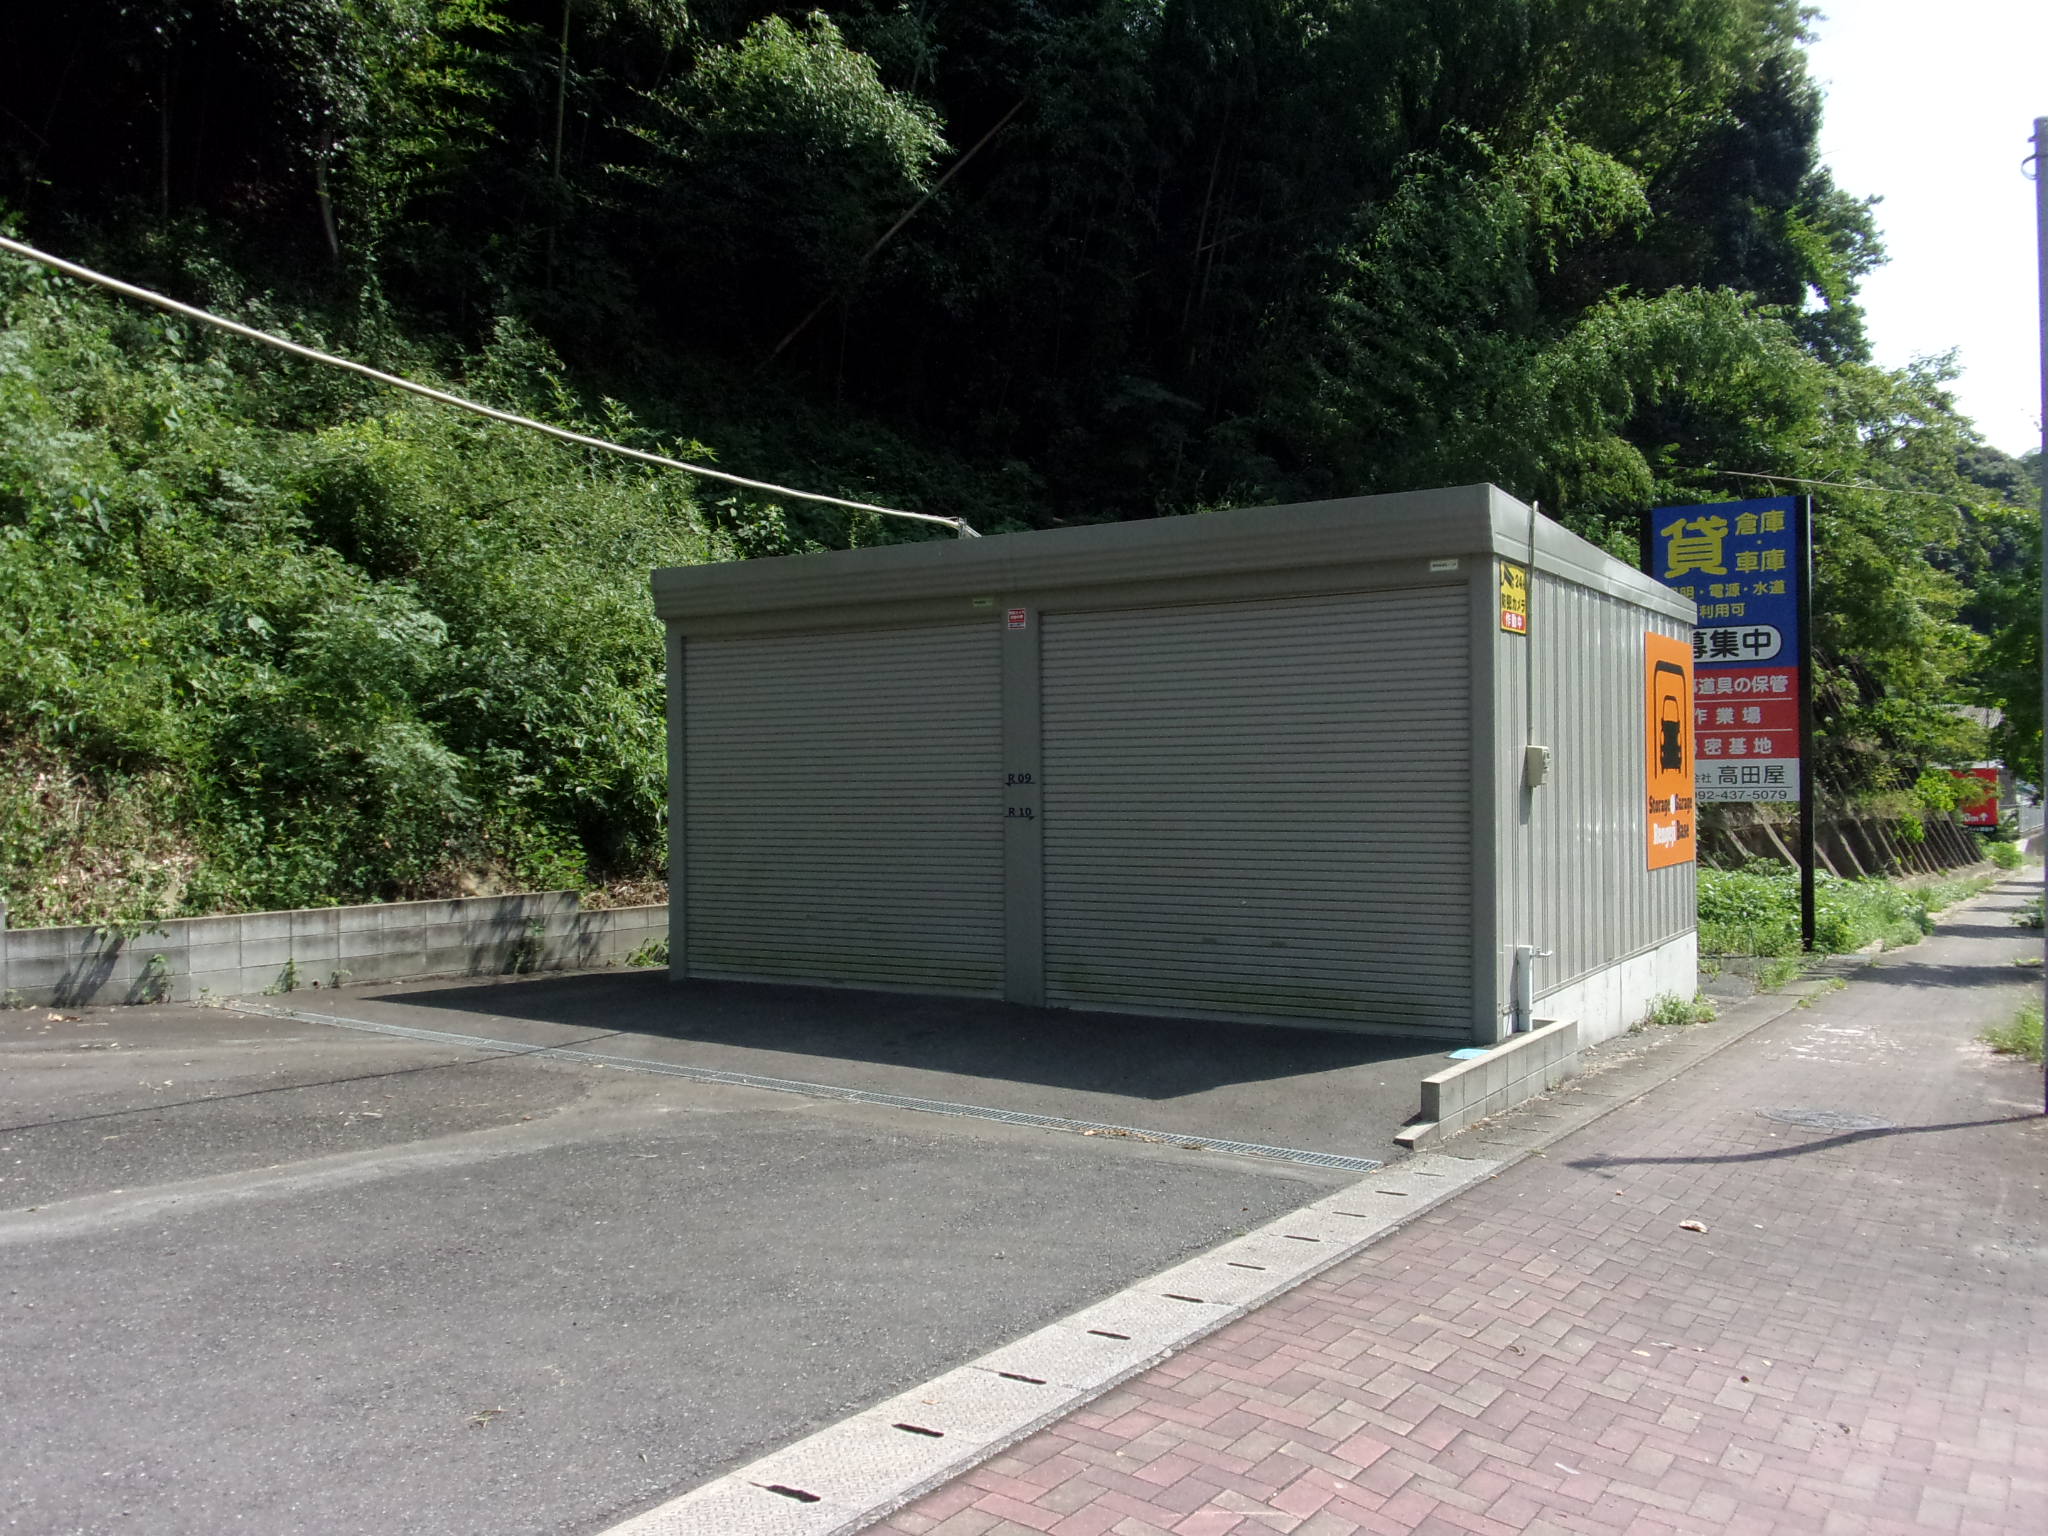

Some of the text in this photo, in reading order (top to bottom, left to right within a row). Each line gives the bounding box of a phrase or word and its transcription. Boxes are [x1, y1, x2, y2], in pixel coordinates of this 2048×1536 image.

[1735, 510, 1785, 535] 倉庫
[1660, 516, 1729, 579] 貸
[1735, 549, 1785, 572] 車庫
[1699, 602, 1746, 619] 利用可
[1694, 675, 1789, 696] 道具の保管
[1694, 737, 1772, 755] 密基地
[1018, 772, 1032, 784] 09
[1718, 765, 1785, 785] 高田屋
[1649, 794, 1670, 816] Storage
[1695, 790, 1787, 801] 92-437-5079
[1008, 807, 1032, 817] R 10
